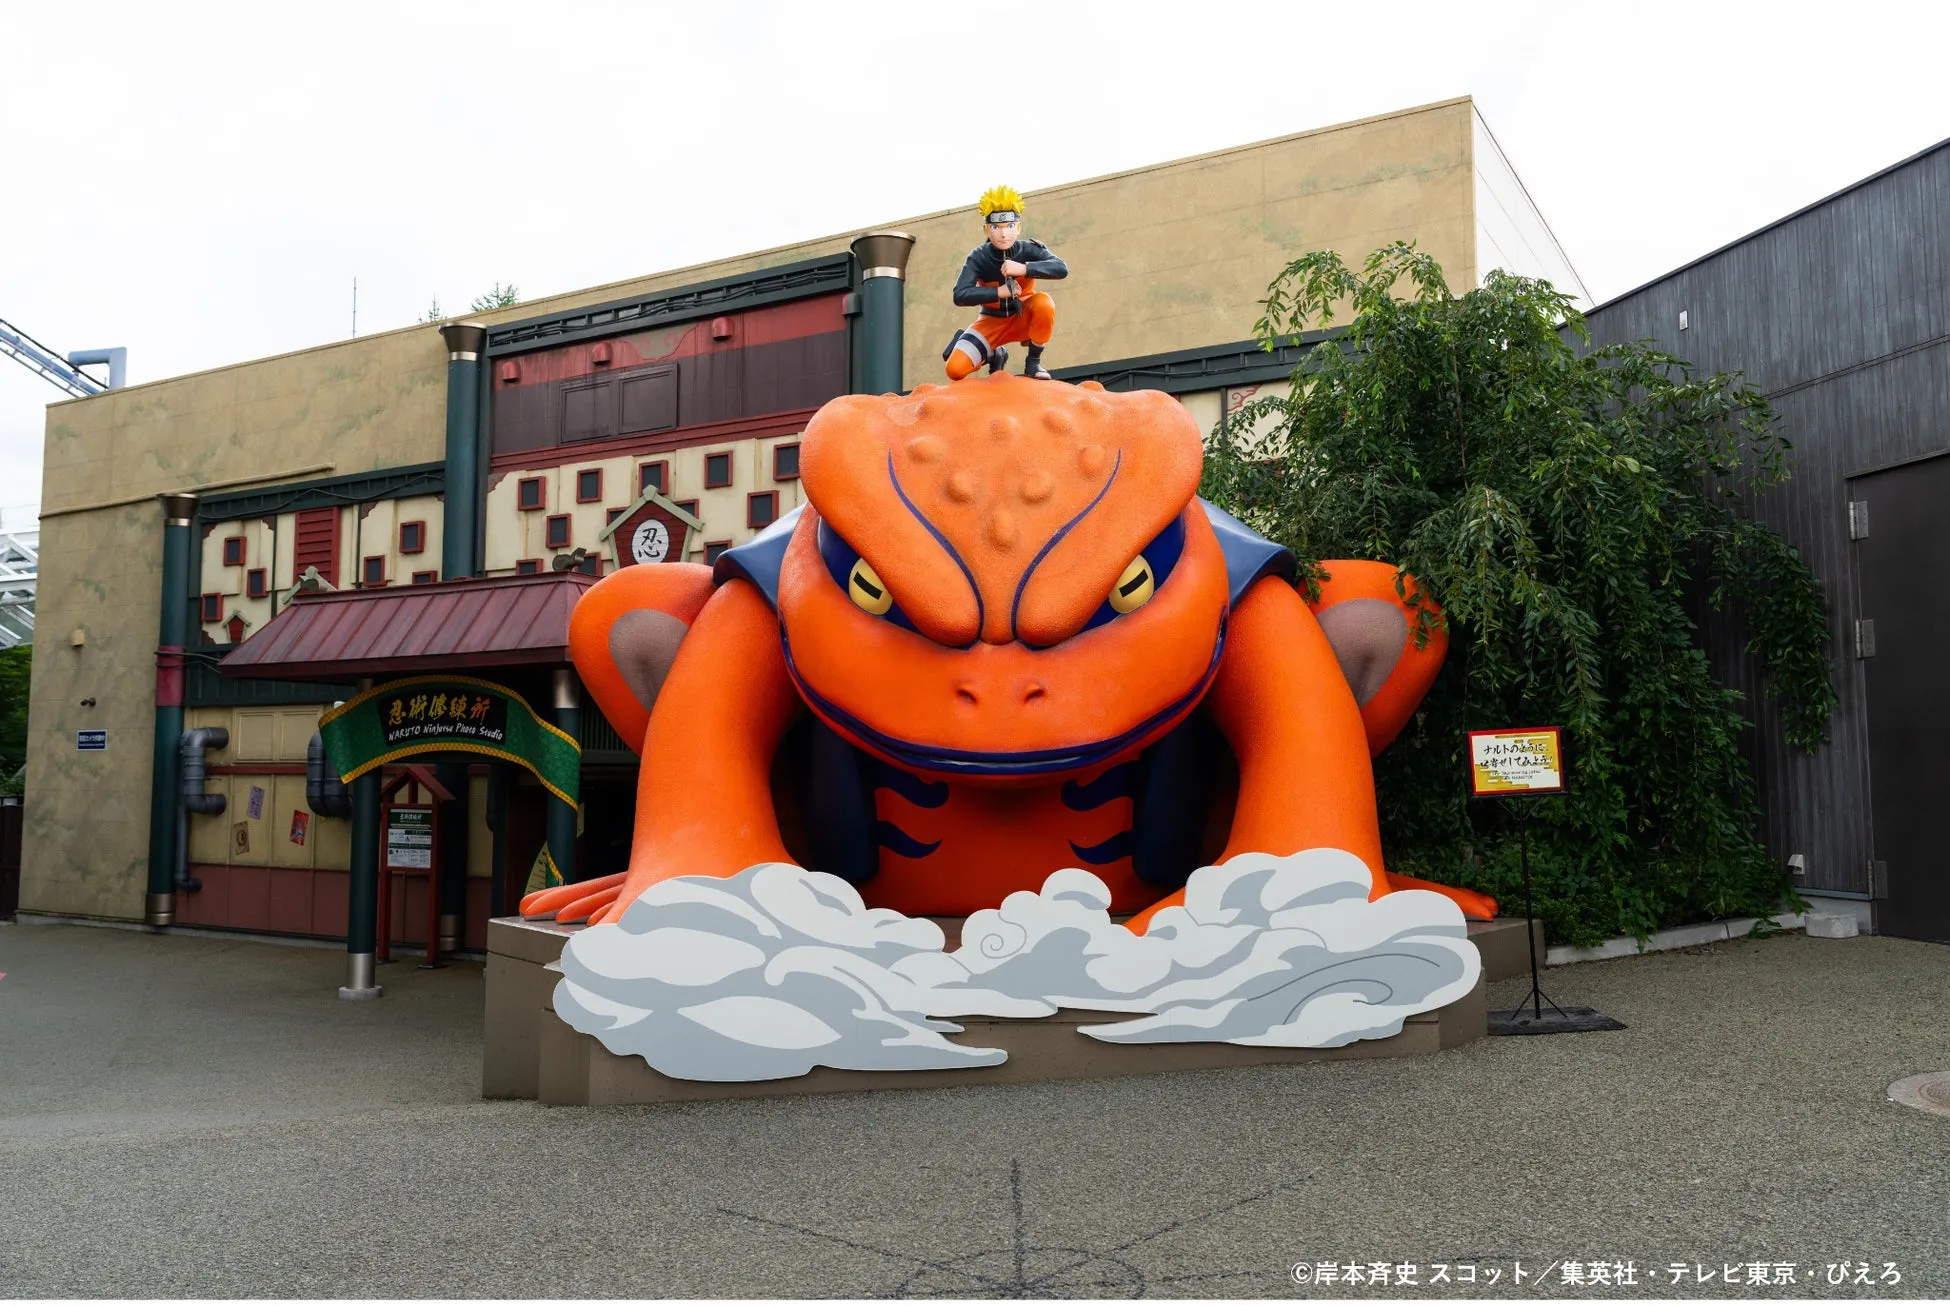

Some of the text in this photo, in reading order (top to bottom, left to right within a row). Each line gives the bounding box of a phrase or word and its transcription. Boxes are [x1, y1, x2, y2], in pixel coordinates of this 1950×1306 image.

[638, 527, 662, 558] 忍
[388, 723, 504, 742] NARUTO Ninjutsu Photo Studio
